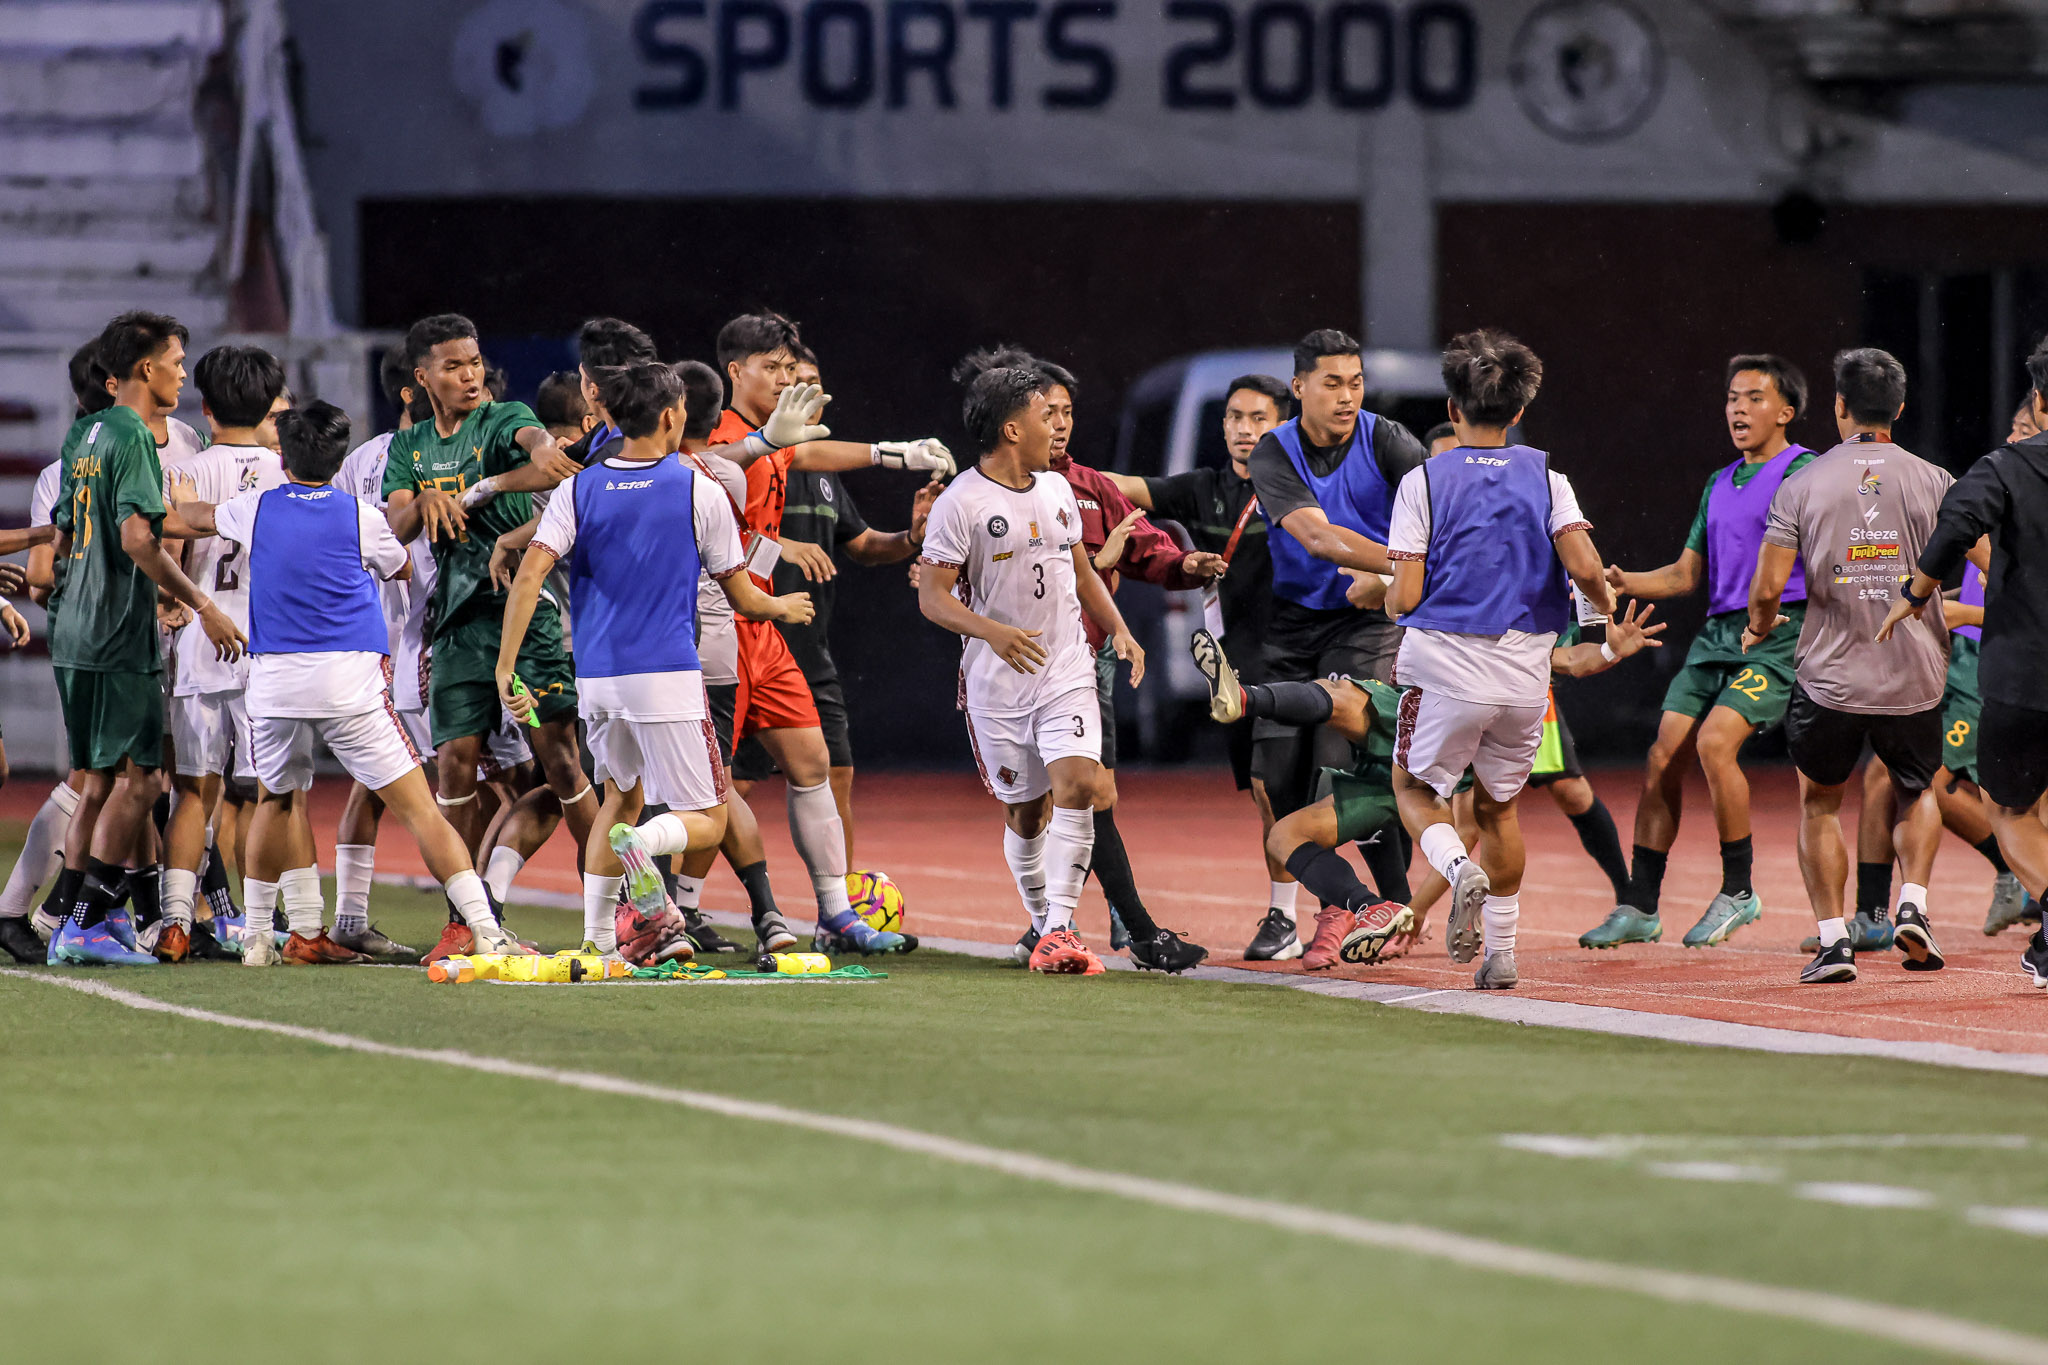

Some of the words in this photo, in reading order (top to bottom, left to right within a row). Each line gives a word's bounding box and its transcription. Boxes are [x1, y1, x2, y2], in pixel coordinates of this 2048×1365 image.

[632, 0, 1118, 111] SPORTS
[1165, 0, 1477, 111] 2000
[1077, 499, 1099, 510] FIFA
[1849, 527, 1899, 541] Steeze
[1848, 545, 1900, 560] TopBreed
[1032, 563, 1045, 600] 3
[1853, 575, 1898, 583] CONMECH
[1729, 668, 1768, 701] 22
[1072, 715, 1084, 738] 3
[1946, 720, 1970, 747] 8
